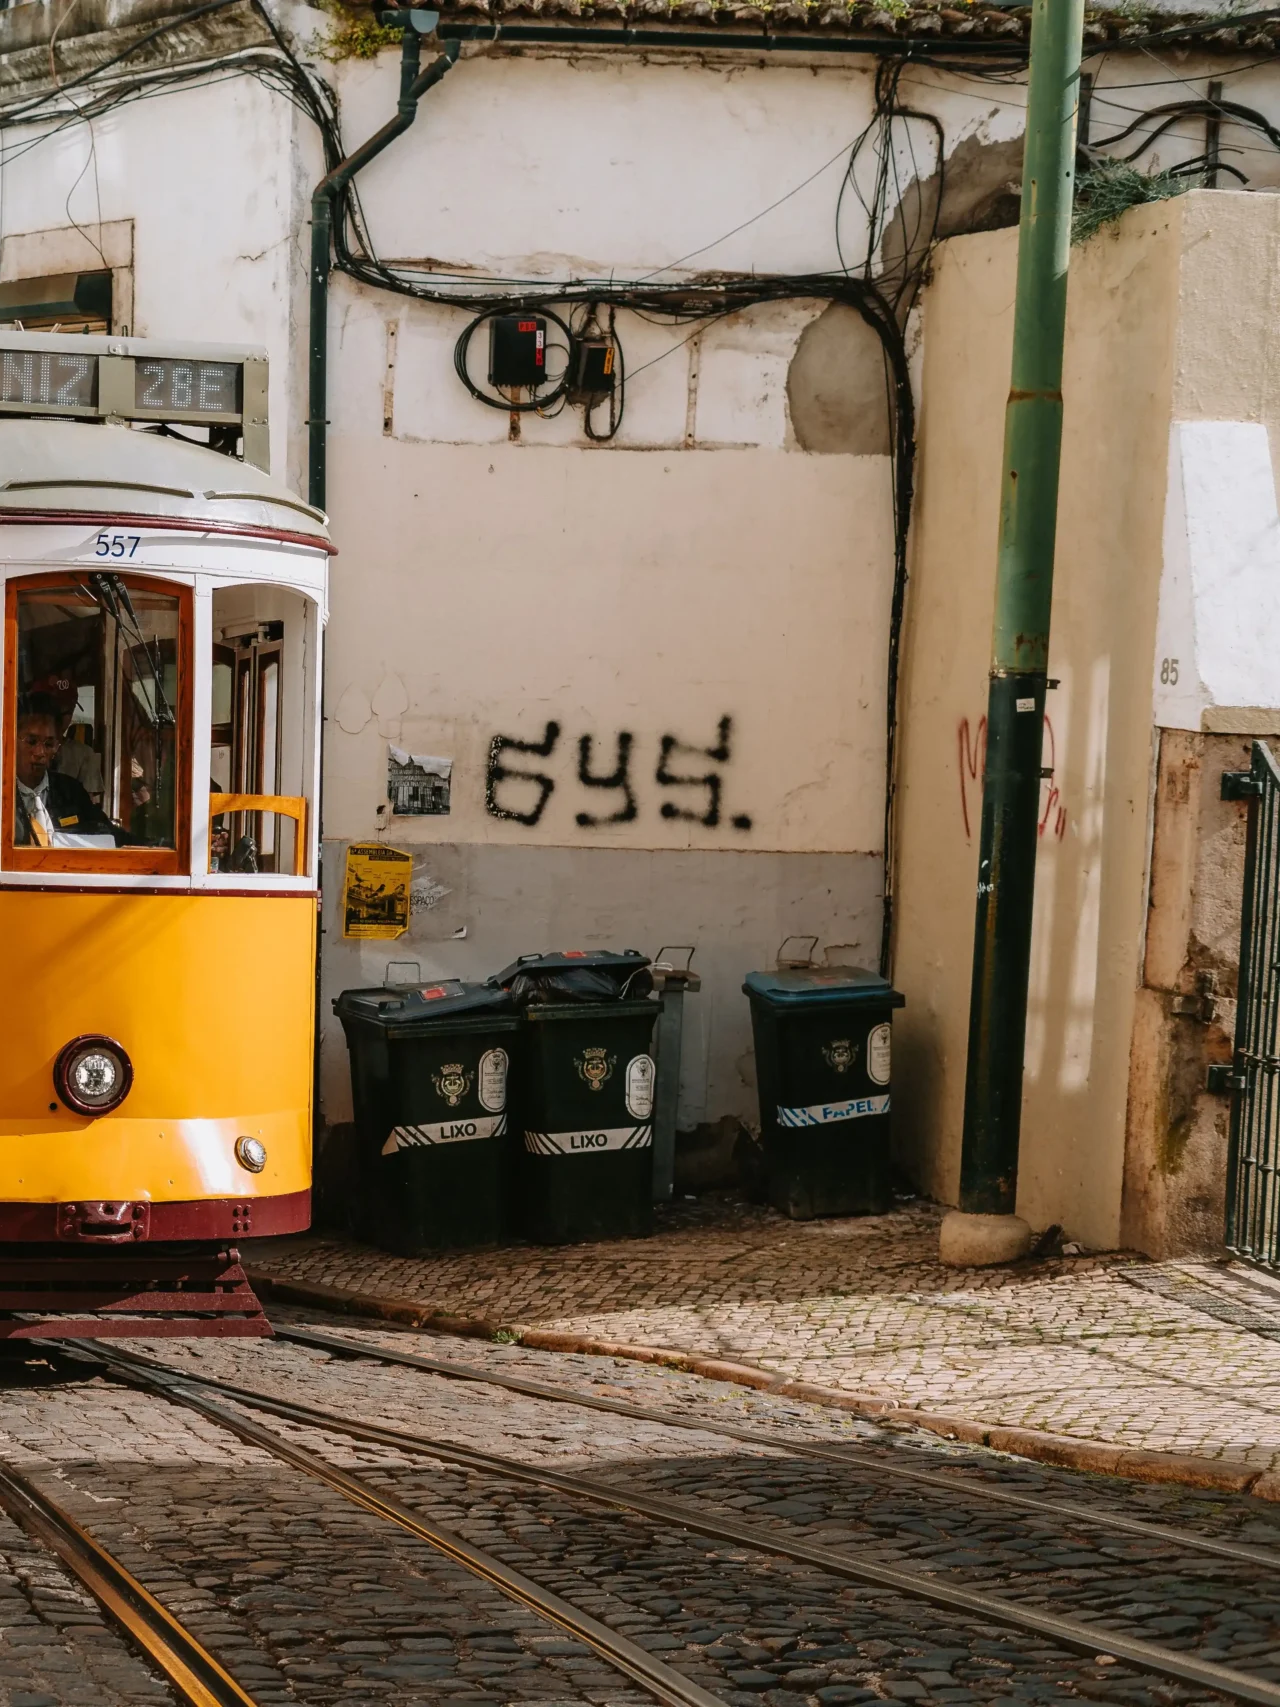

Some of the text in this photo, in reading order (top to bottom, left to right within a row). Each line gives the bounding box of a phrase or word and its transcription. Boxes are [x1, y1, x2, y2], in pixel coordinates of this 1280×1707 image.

[143, 365, 225, 409] 28E
[95, 534, 141, 558] 557
[1160, 657, 1179, 685] 85
[440, 1123, 477, 1139] LIXO
[570, 1134, 608, 1149] LIXO
